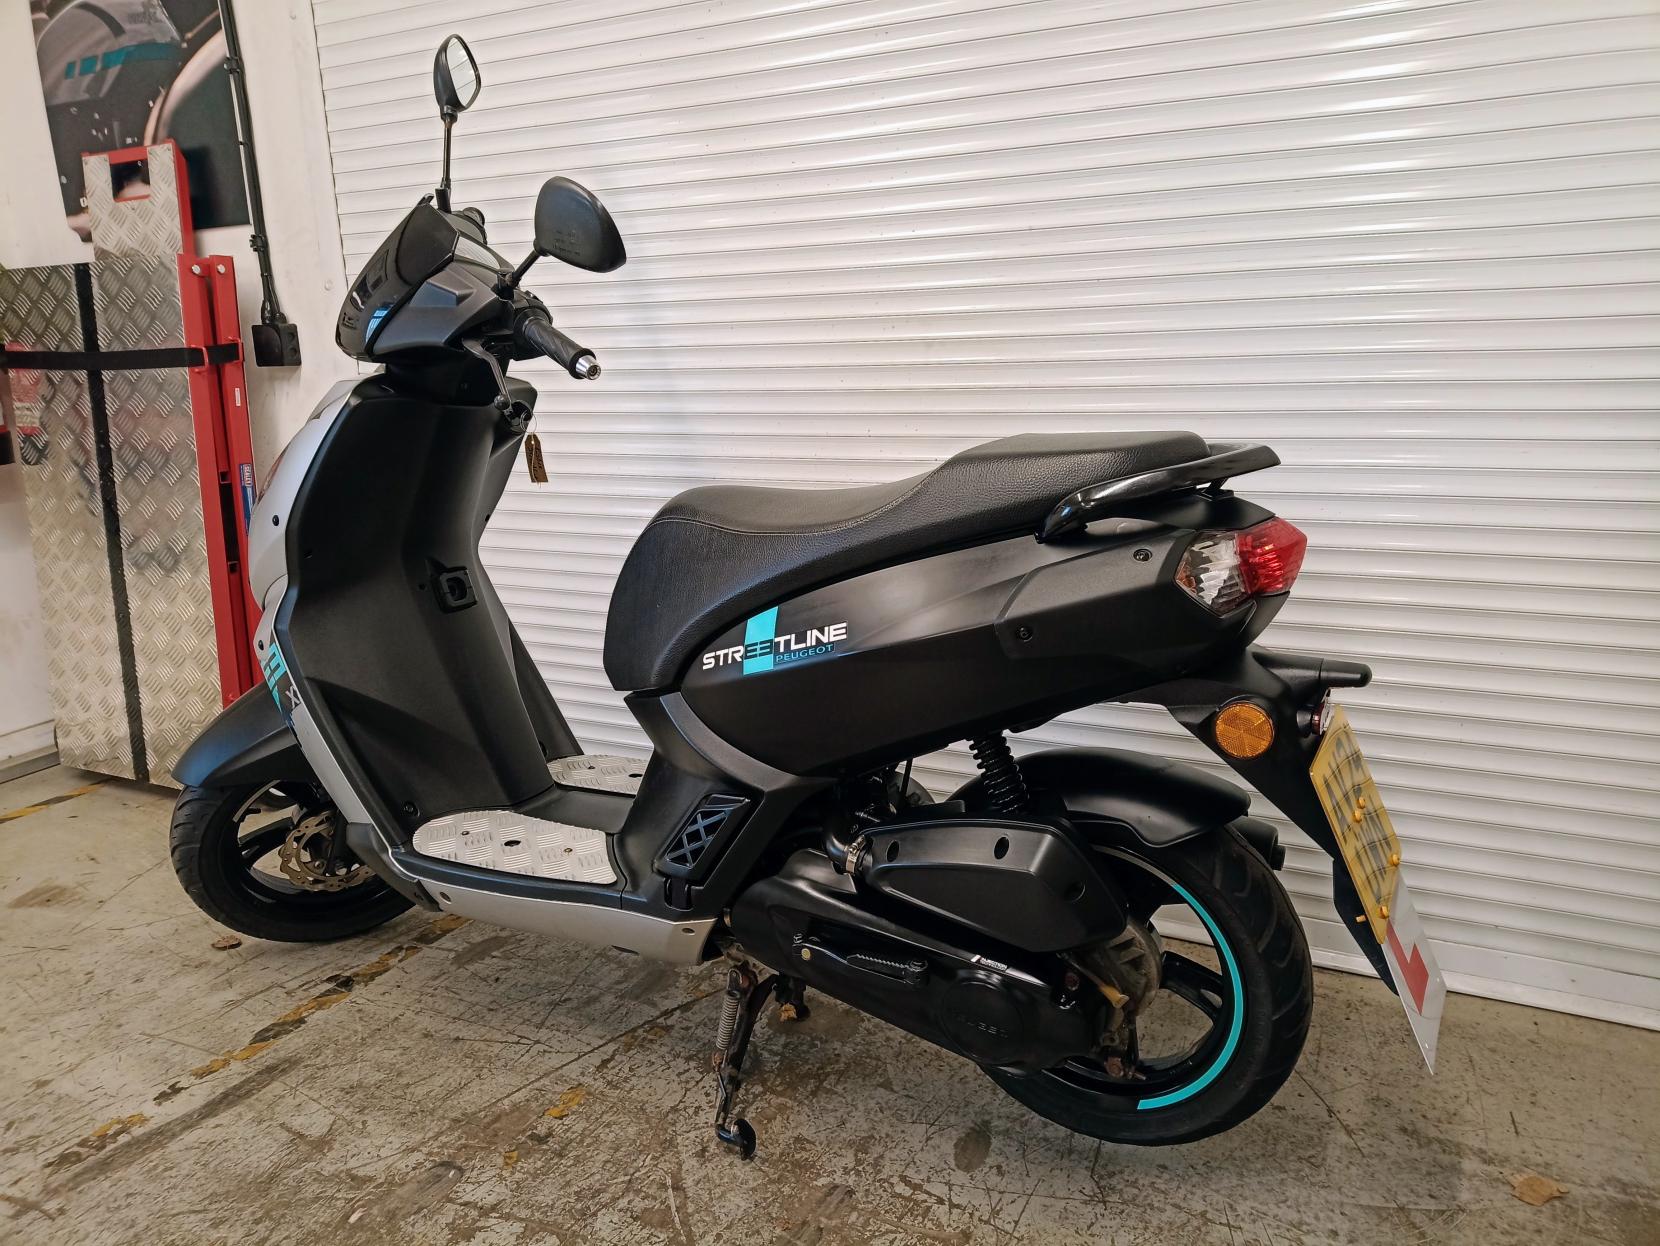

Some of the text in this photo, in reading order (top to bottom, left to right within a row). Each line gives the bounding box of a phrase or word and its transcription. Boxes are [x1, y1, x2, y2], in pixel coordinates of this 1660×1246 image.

[702, 622, 848, 670] STREETLINE
[775, 643, 834, 664] PEUGEOT
[1386, 919, 1429, 1017] L
